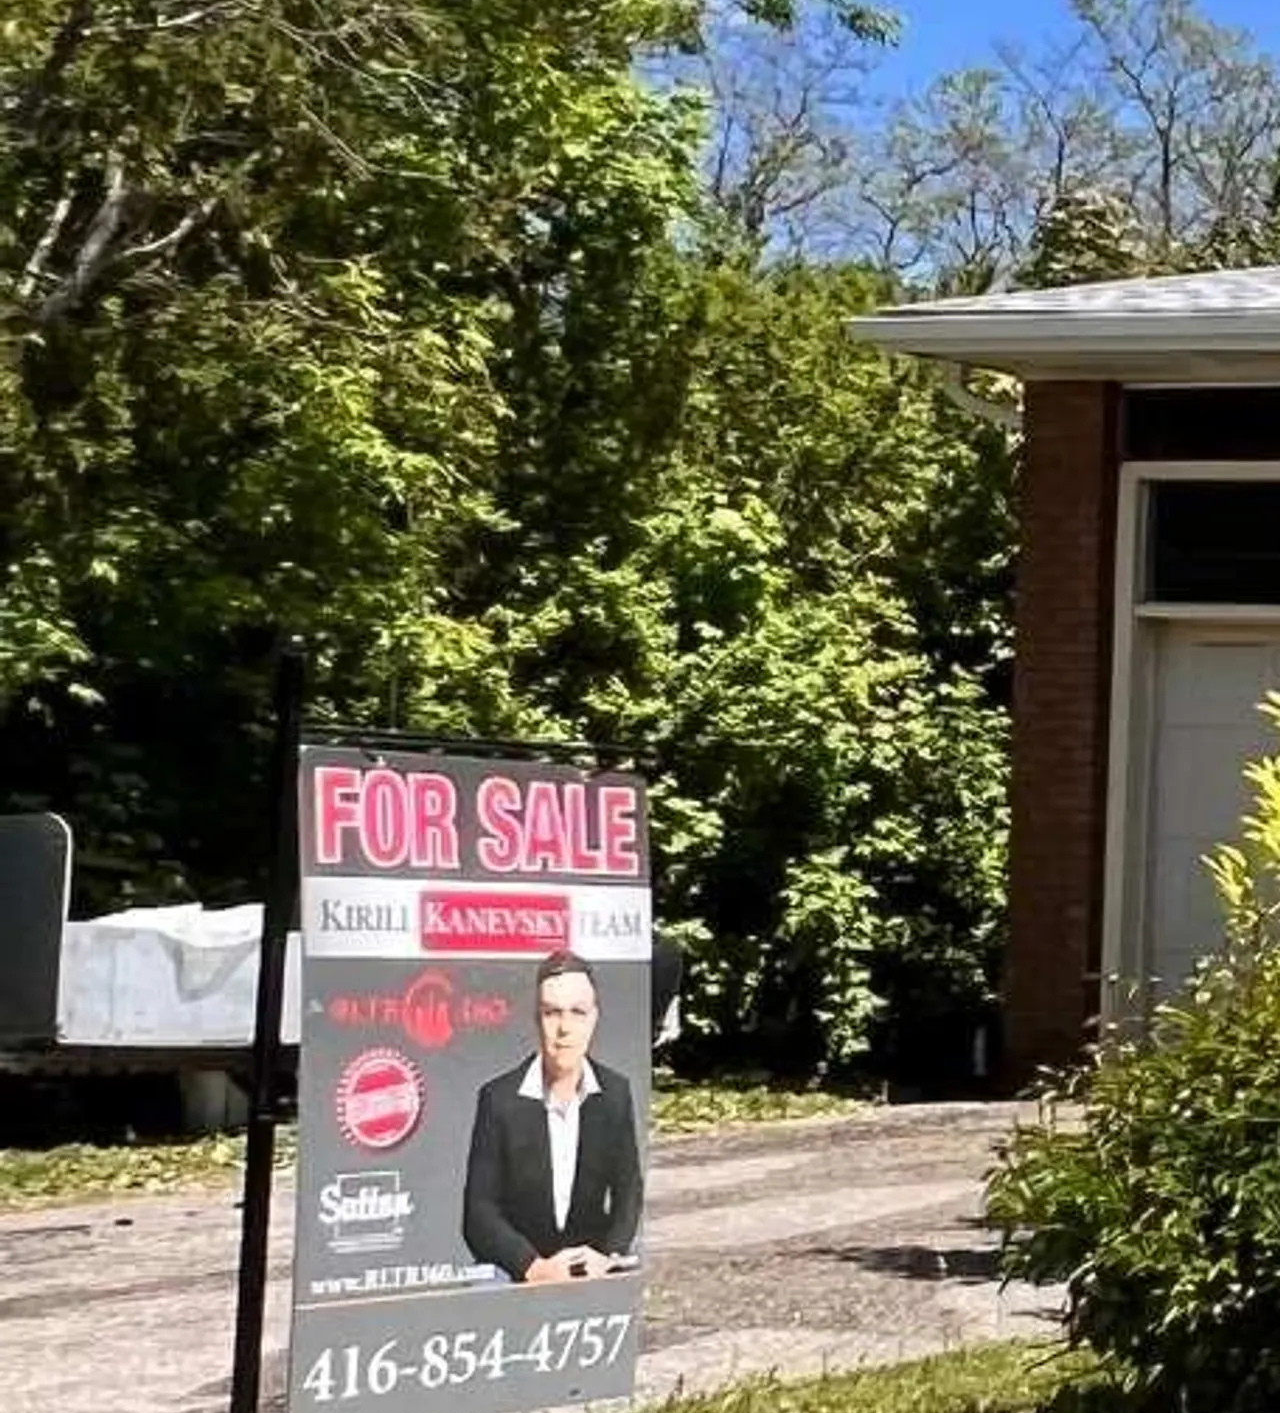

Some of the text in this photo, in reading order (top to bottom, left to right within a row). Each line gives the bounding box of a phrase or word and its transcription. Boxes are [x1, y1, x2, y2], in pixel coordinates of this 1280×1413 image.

[313, 766, 640, 875] FOR SALE
[424, 900, 566, 935] KANEVSKY
[579, 909, 642, 938] TEAM
[303, 1314, 630, 1401] 416-854-4757
